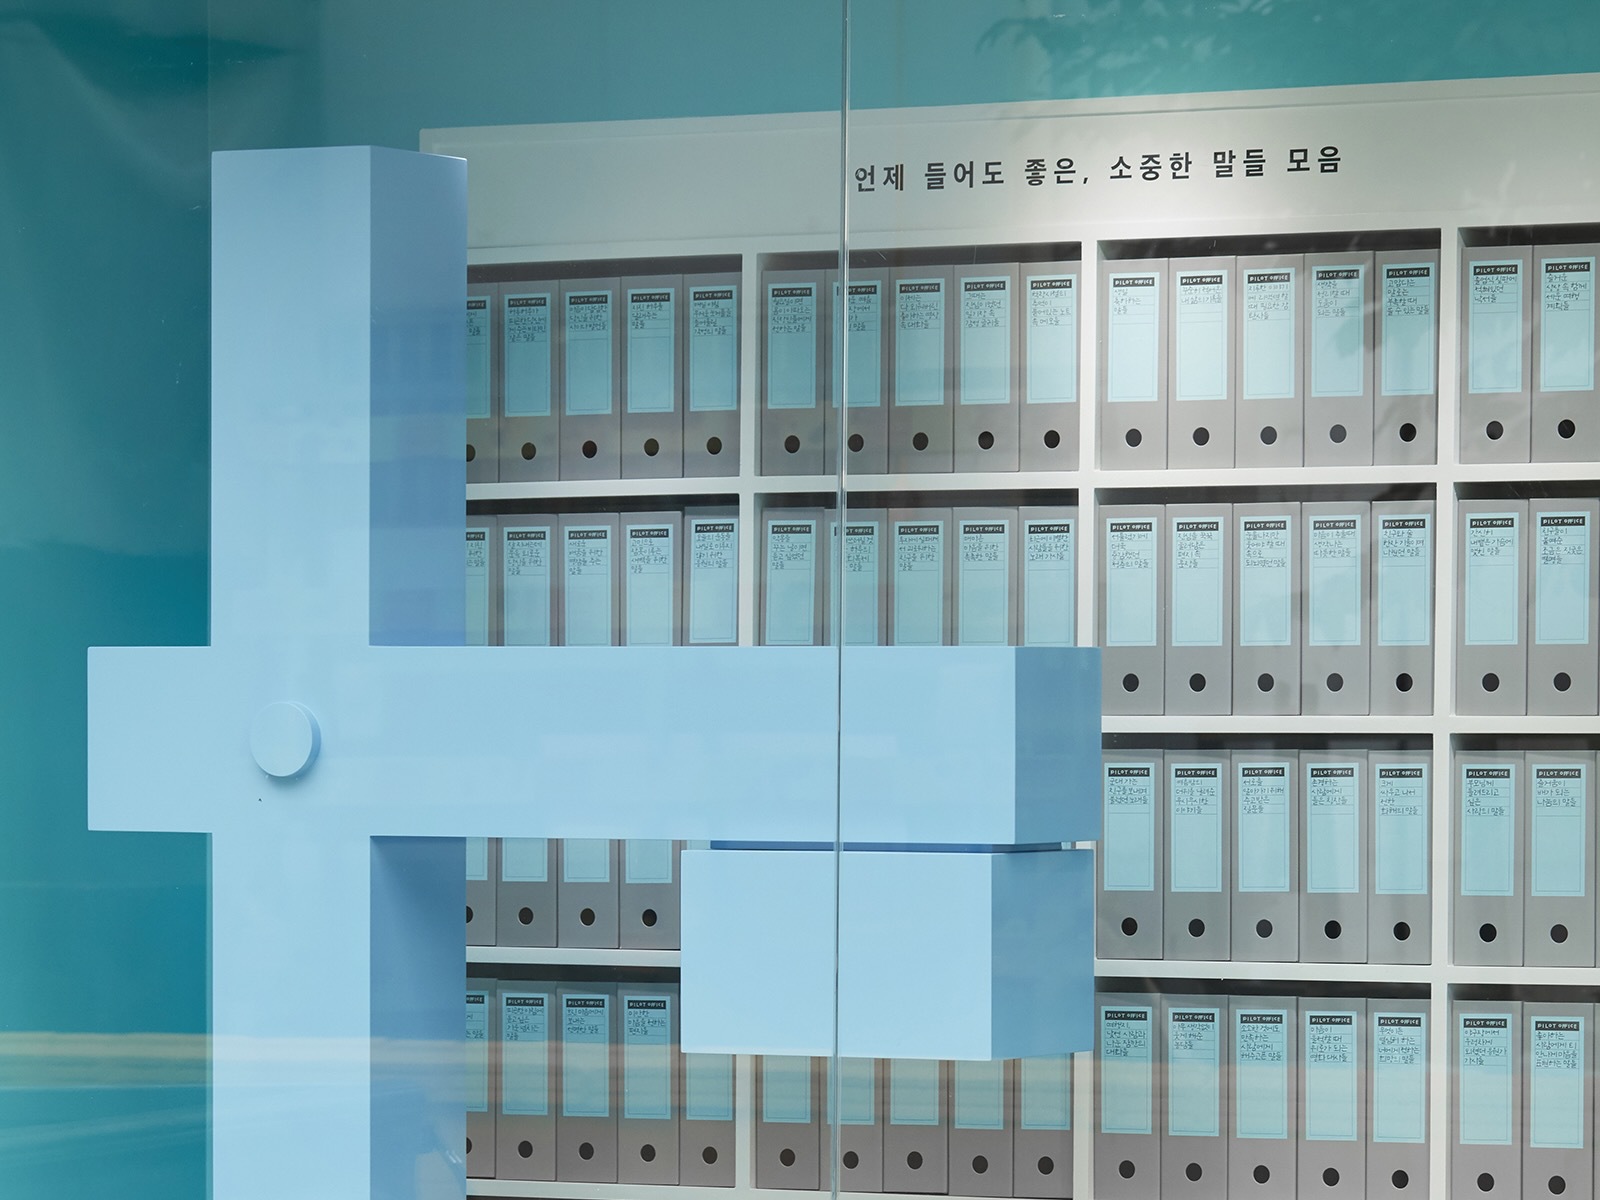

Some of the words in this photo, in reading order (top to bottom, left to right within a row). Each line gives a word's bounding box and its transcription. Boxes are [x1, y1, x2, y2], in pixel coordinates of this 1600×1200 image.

[854, 164, 905, 192] 언제
[924, 160, 1005, 190] 들어도
[1024, 157, 1089, 187] 좋은,
[1109, 151, 1193, 181] 소중한
[1213, 148, 1266, 178] 말들
[1286, 145, 1341, 174] 모음
